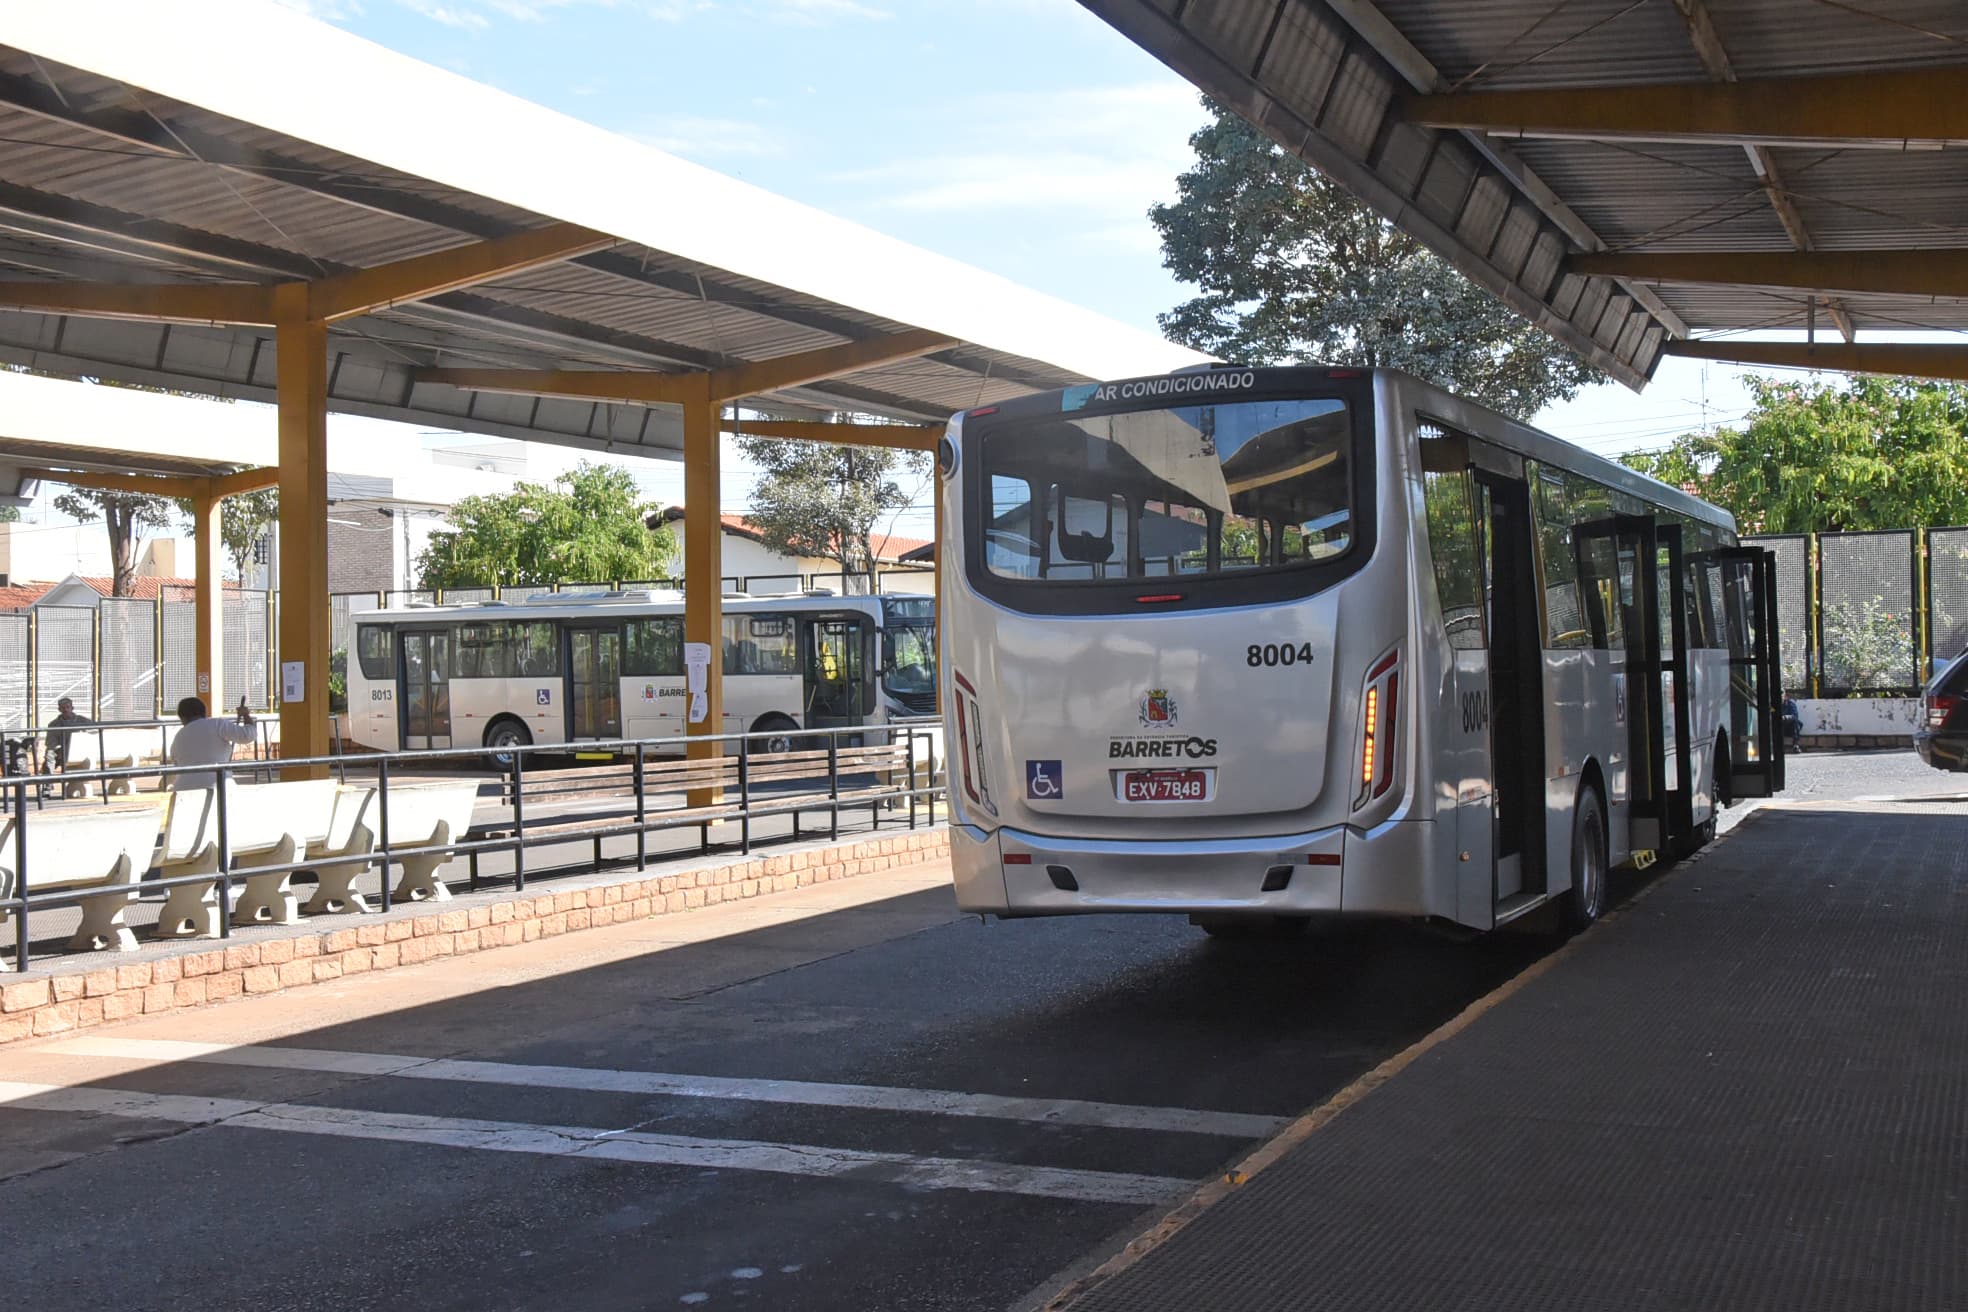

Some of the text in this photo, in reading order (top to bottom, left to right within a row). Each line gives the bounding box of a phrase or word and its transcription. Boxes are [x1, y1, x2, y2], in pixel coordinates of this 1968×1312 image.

[1095, 372, 1254, 401] AR CONDICIONADO
[1247, 642, 1314, 667] 8004
[371, 689, 392, 701] 8013
[658, 688, 686, 697] BARRE
[1109, 736, 1217, 758] BARRETOS
